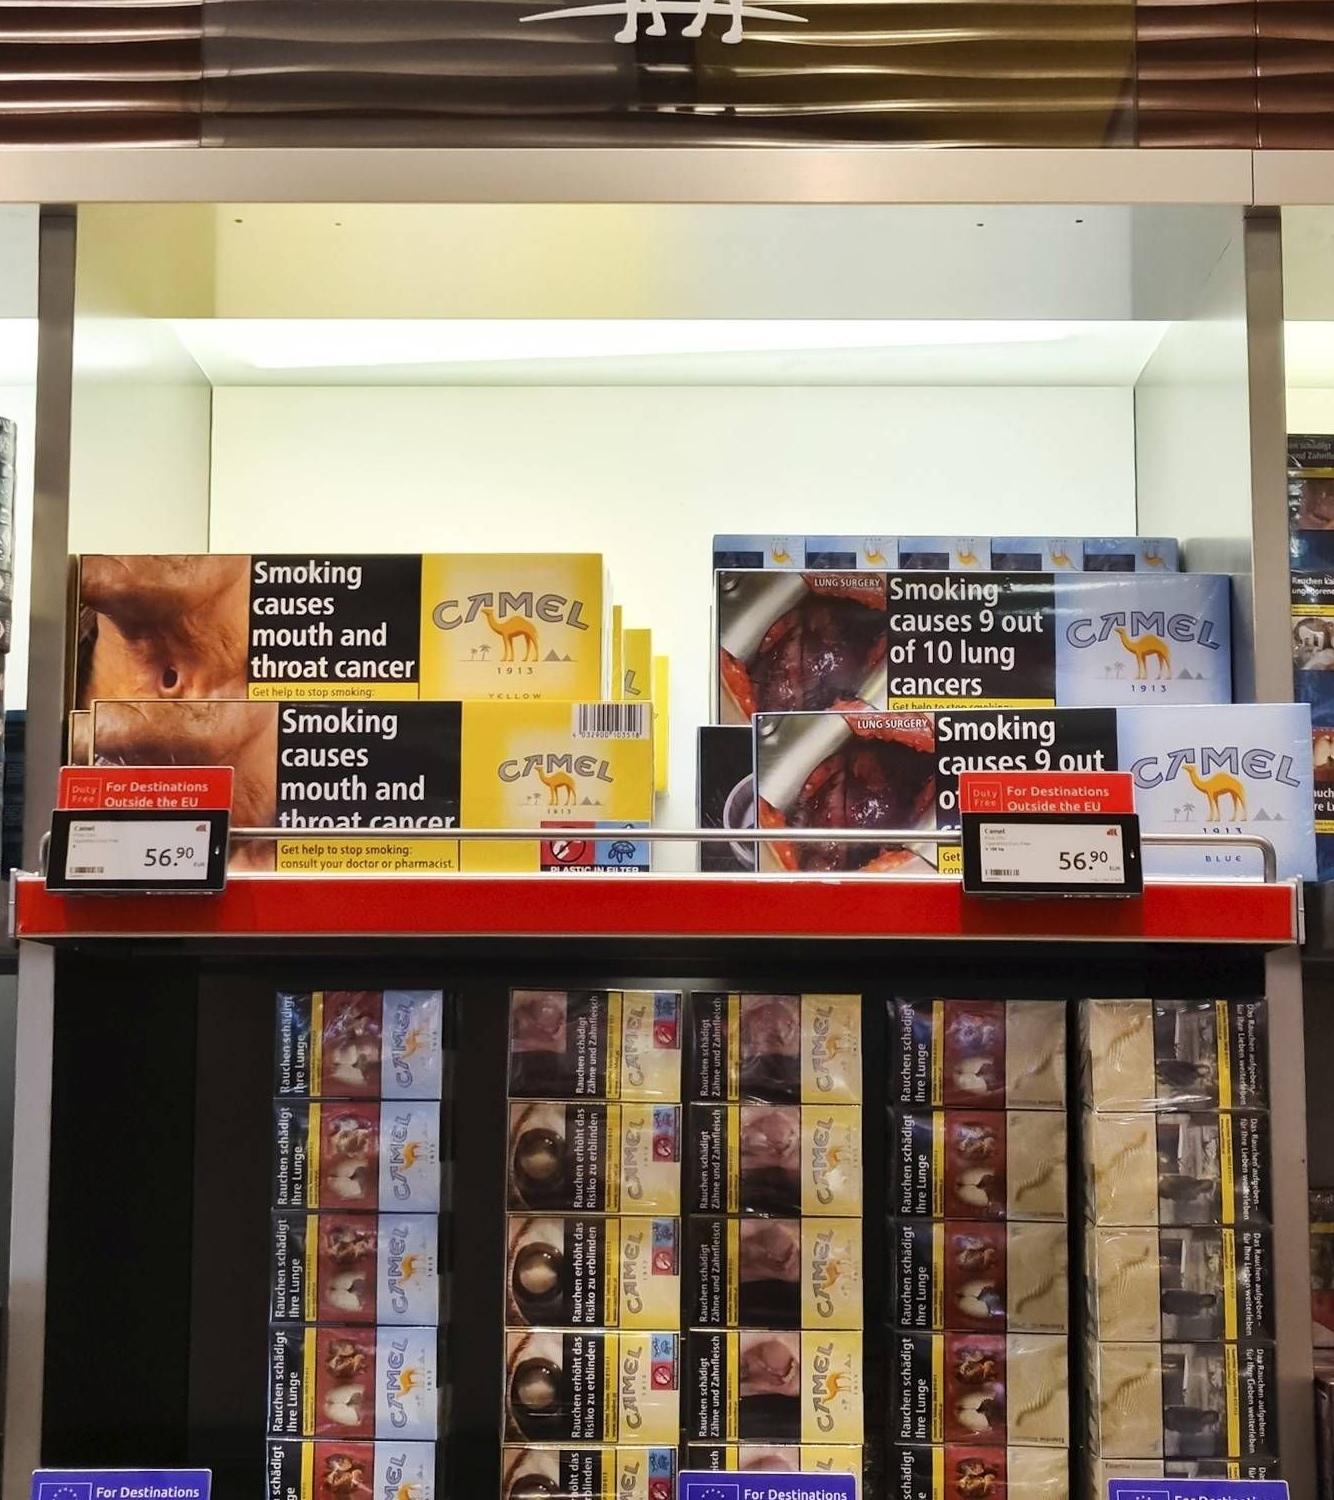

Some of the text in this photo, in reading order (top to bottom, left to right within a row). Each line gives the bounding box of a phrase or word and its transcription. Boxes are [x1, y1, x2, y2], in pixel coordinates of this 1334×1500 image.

[254, 560, 362, 590] Smoking
[814, 578, 880, 588] LUNG SURGERY
[890, 579, 999, 608] Smoking
[253, 595, 335, 616] causes
[432, 591, 590, 631] CAMEL
[890, 610, 1043, 633] causes 9 out
[1066, 611, 1220, 650] CAMEL
[252, 622, 387, 647] mouth and
[890, 640, 1015, 670] of 10 lung
[251, 654, 415, 679] throat cancer
[496, 667, 534, 675] 1913
[252, 687, 375, 699] Get help to stop smoking:
[488, 692, 543, 700] YELLOW
[890, 675, 982, 696] cancers
[1131, 684, 1167, 693] 1913
[282, 708, 399, 740] Smoking
[857, 718, 928, 729] LUNG SURGERY
[938, 715, 1056, 744] Smoking
[280, 746, 369, 768] causes
[938, 750, 1104, 775] causes 9 out
[497, 754, 614, 783] CAMEL
[1131, 747, 1301, 789] CAMEL
[72, 786, 98, 795] Duty
[106, 782, 208, 792] For Destinations
[280, 775, 425, 801] mouth and
[973, 789, 997, 798] Duty
[1007, 786, 1109, 797] For Destinations
[72, 795, 95, 803] Free
[105, 797, 198, 808] Outside the EU
[974, 799, 997, 807] Free
[1007, 800, 1101, 811] Outside the EU
[279, 808, 455, 828] throat cancer
[144, 847, 194, 867] 56.90
[281, 844, 413, 858] Get help to stop smoking:
[1059, 851, 1108, 870] 56.90
[1205, 855, 1242, 863] BLUE
[281, 859, 454, 872] consult your doctor or pharmacist.
[572, 1222, 583, 1322] Rauchen erhöht das
[585, 1227, 597, 1322] Risiko zu erblinden
[273, 1331, 287, 1432] Rauchen schädigt
[387, 1338, 409, 1429] CAMEL
[710, 1336, 720, 1437] Zähne und Zahnfleisch
[813, 1342, 834, 1432] CAMEL
[286, 1372, 301, 1432] Ihre Lunge
[699, 1358, 710, 1437] Rauchen schädigt
[97, 1487, 199, 1498] For Destinations
